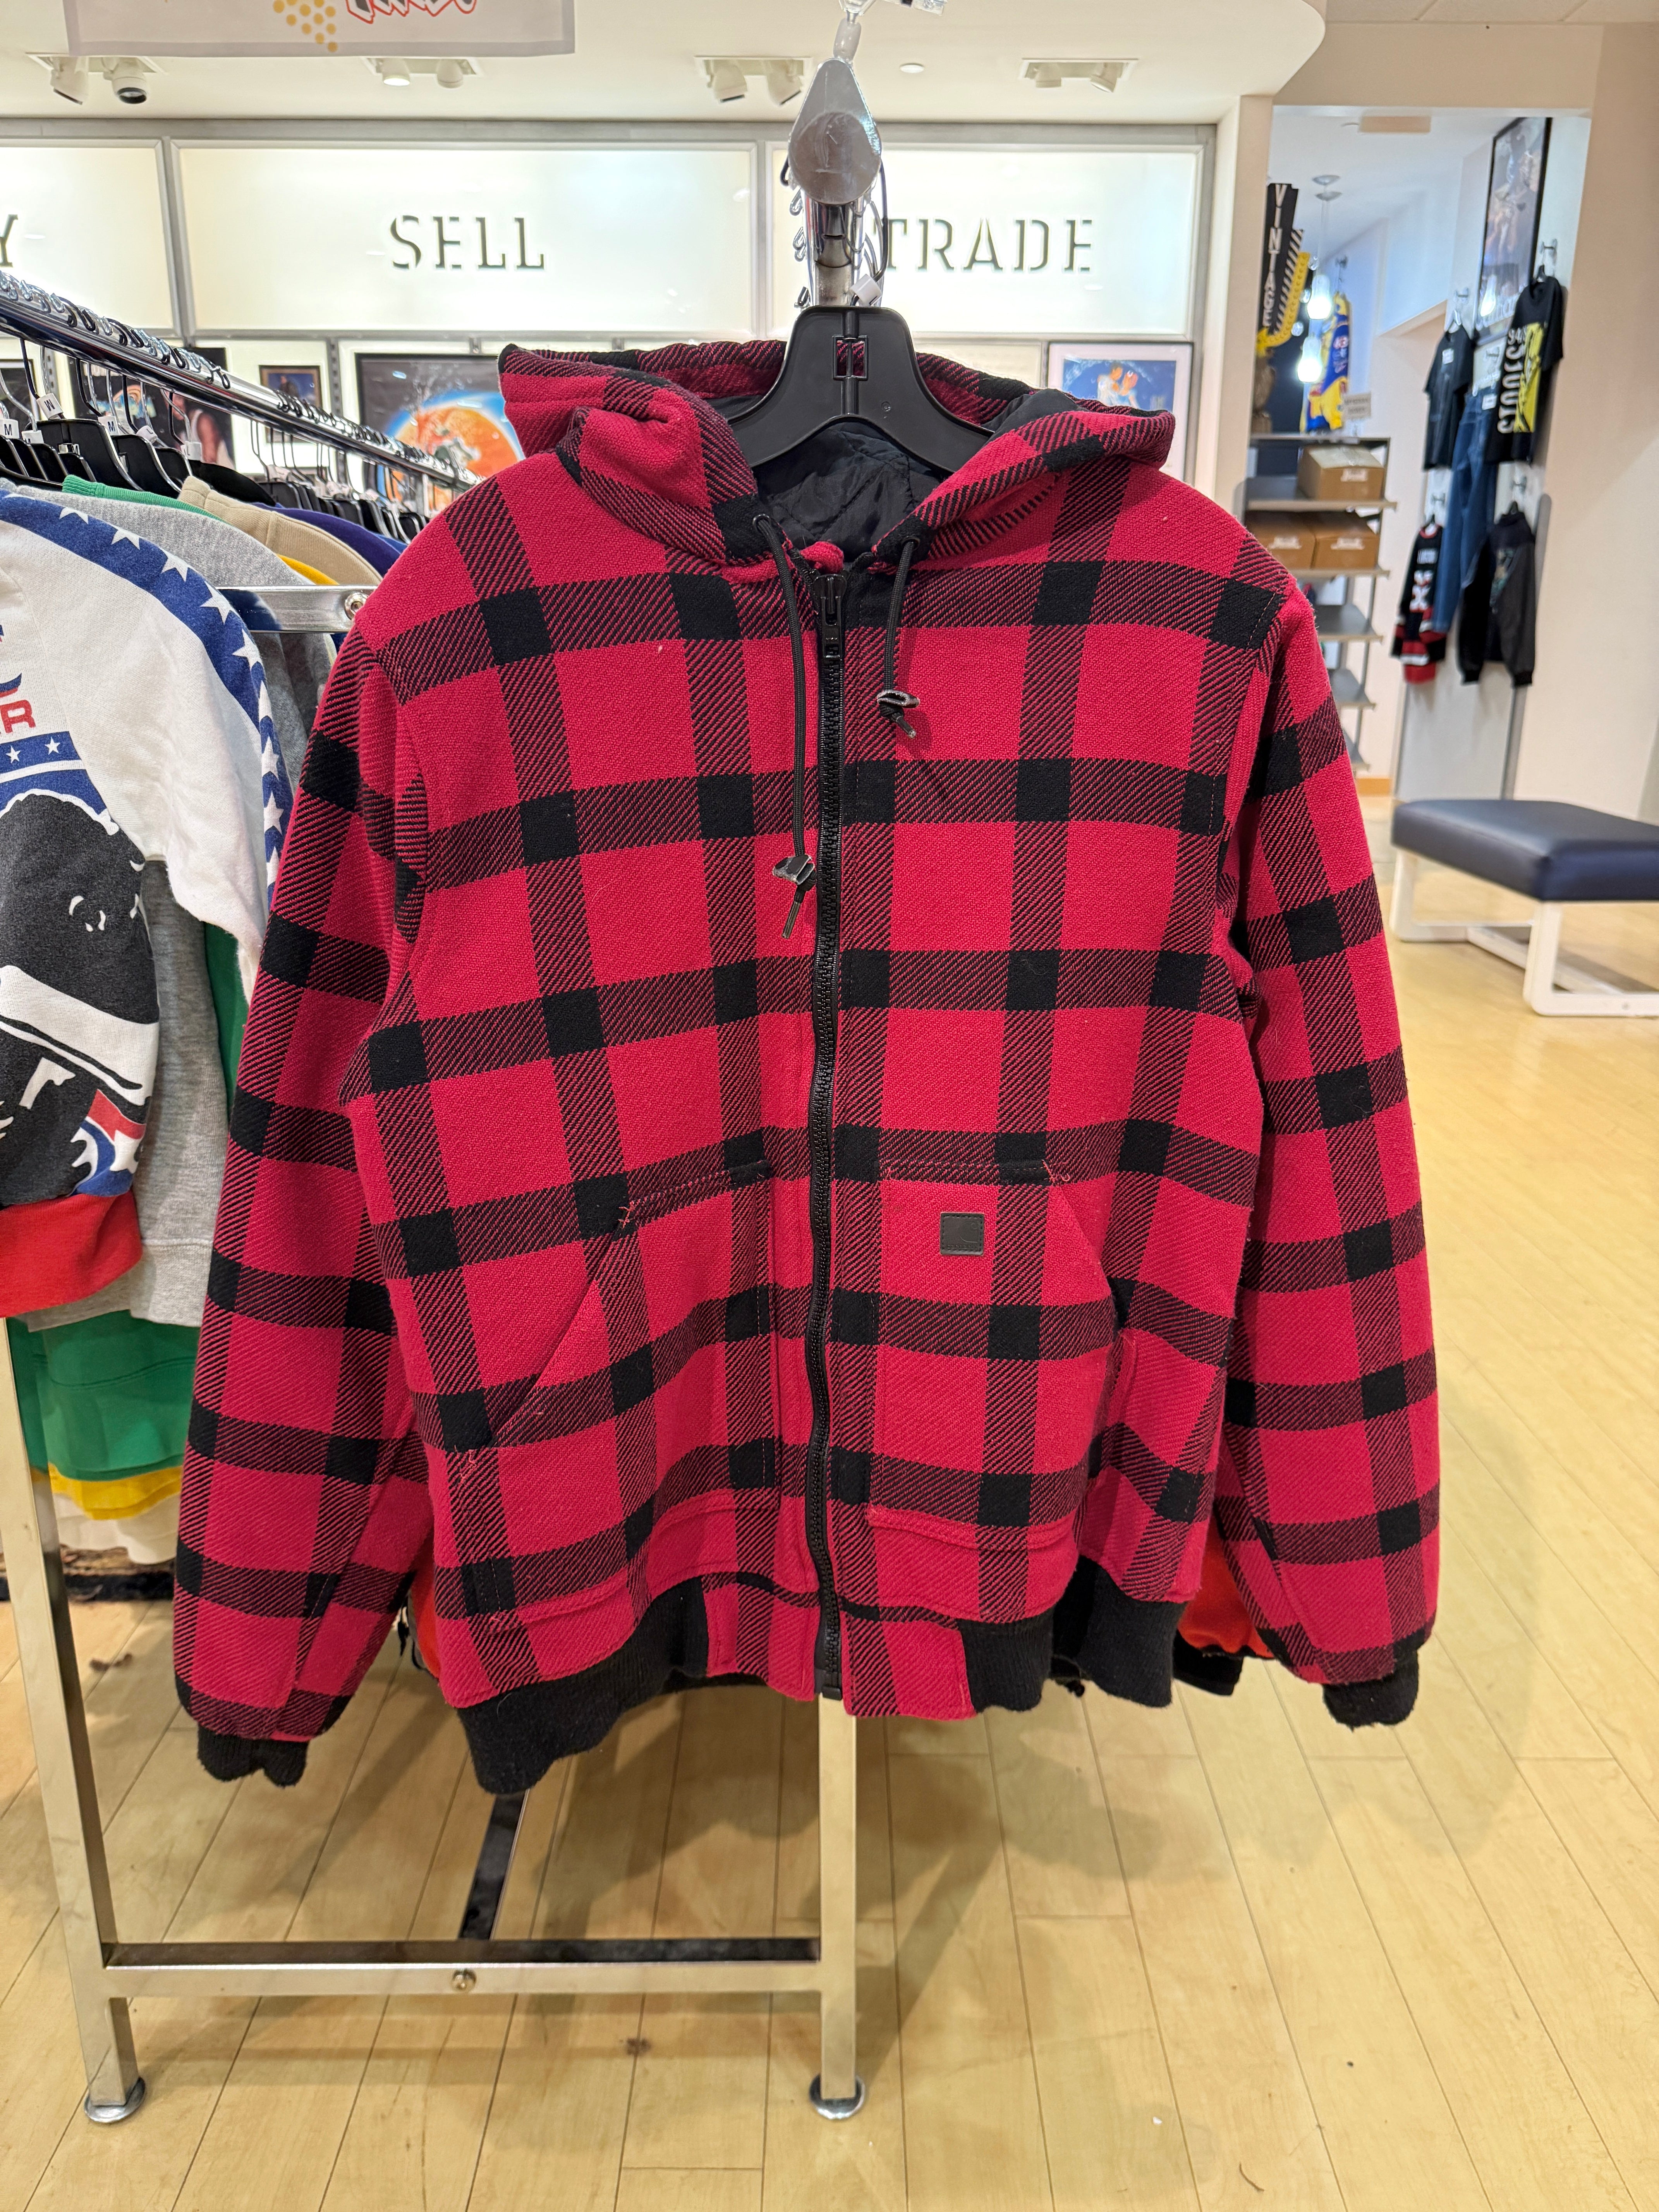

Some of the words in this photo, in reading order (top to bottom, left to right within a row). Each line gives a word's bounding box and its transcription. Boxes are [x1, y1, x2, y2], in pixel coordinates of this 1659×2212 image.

[390, 215, 544, 270] SELL
[872, 217, 1092, 271] TRADE
[1262, 183, 1288, 326] VINTAGE
[4, 424, 12, 436] M
[108, 421, 115, 432] M
